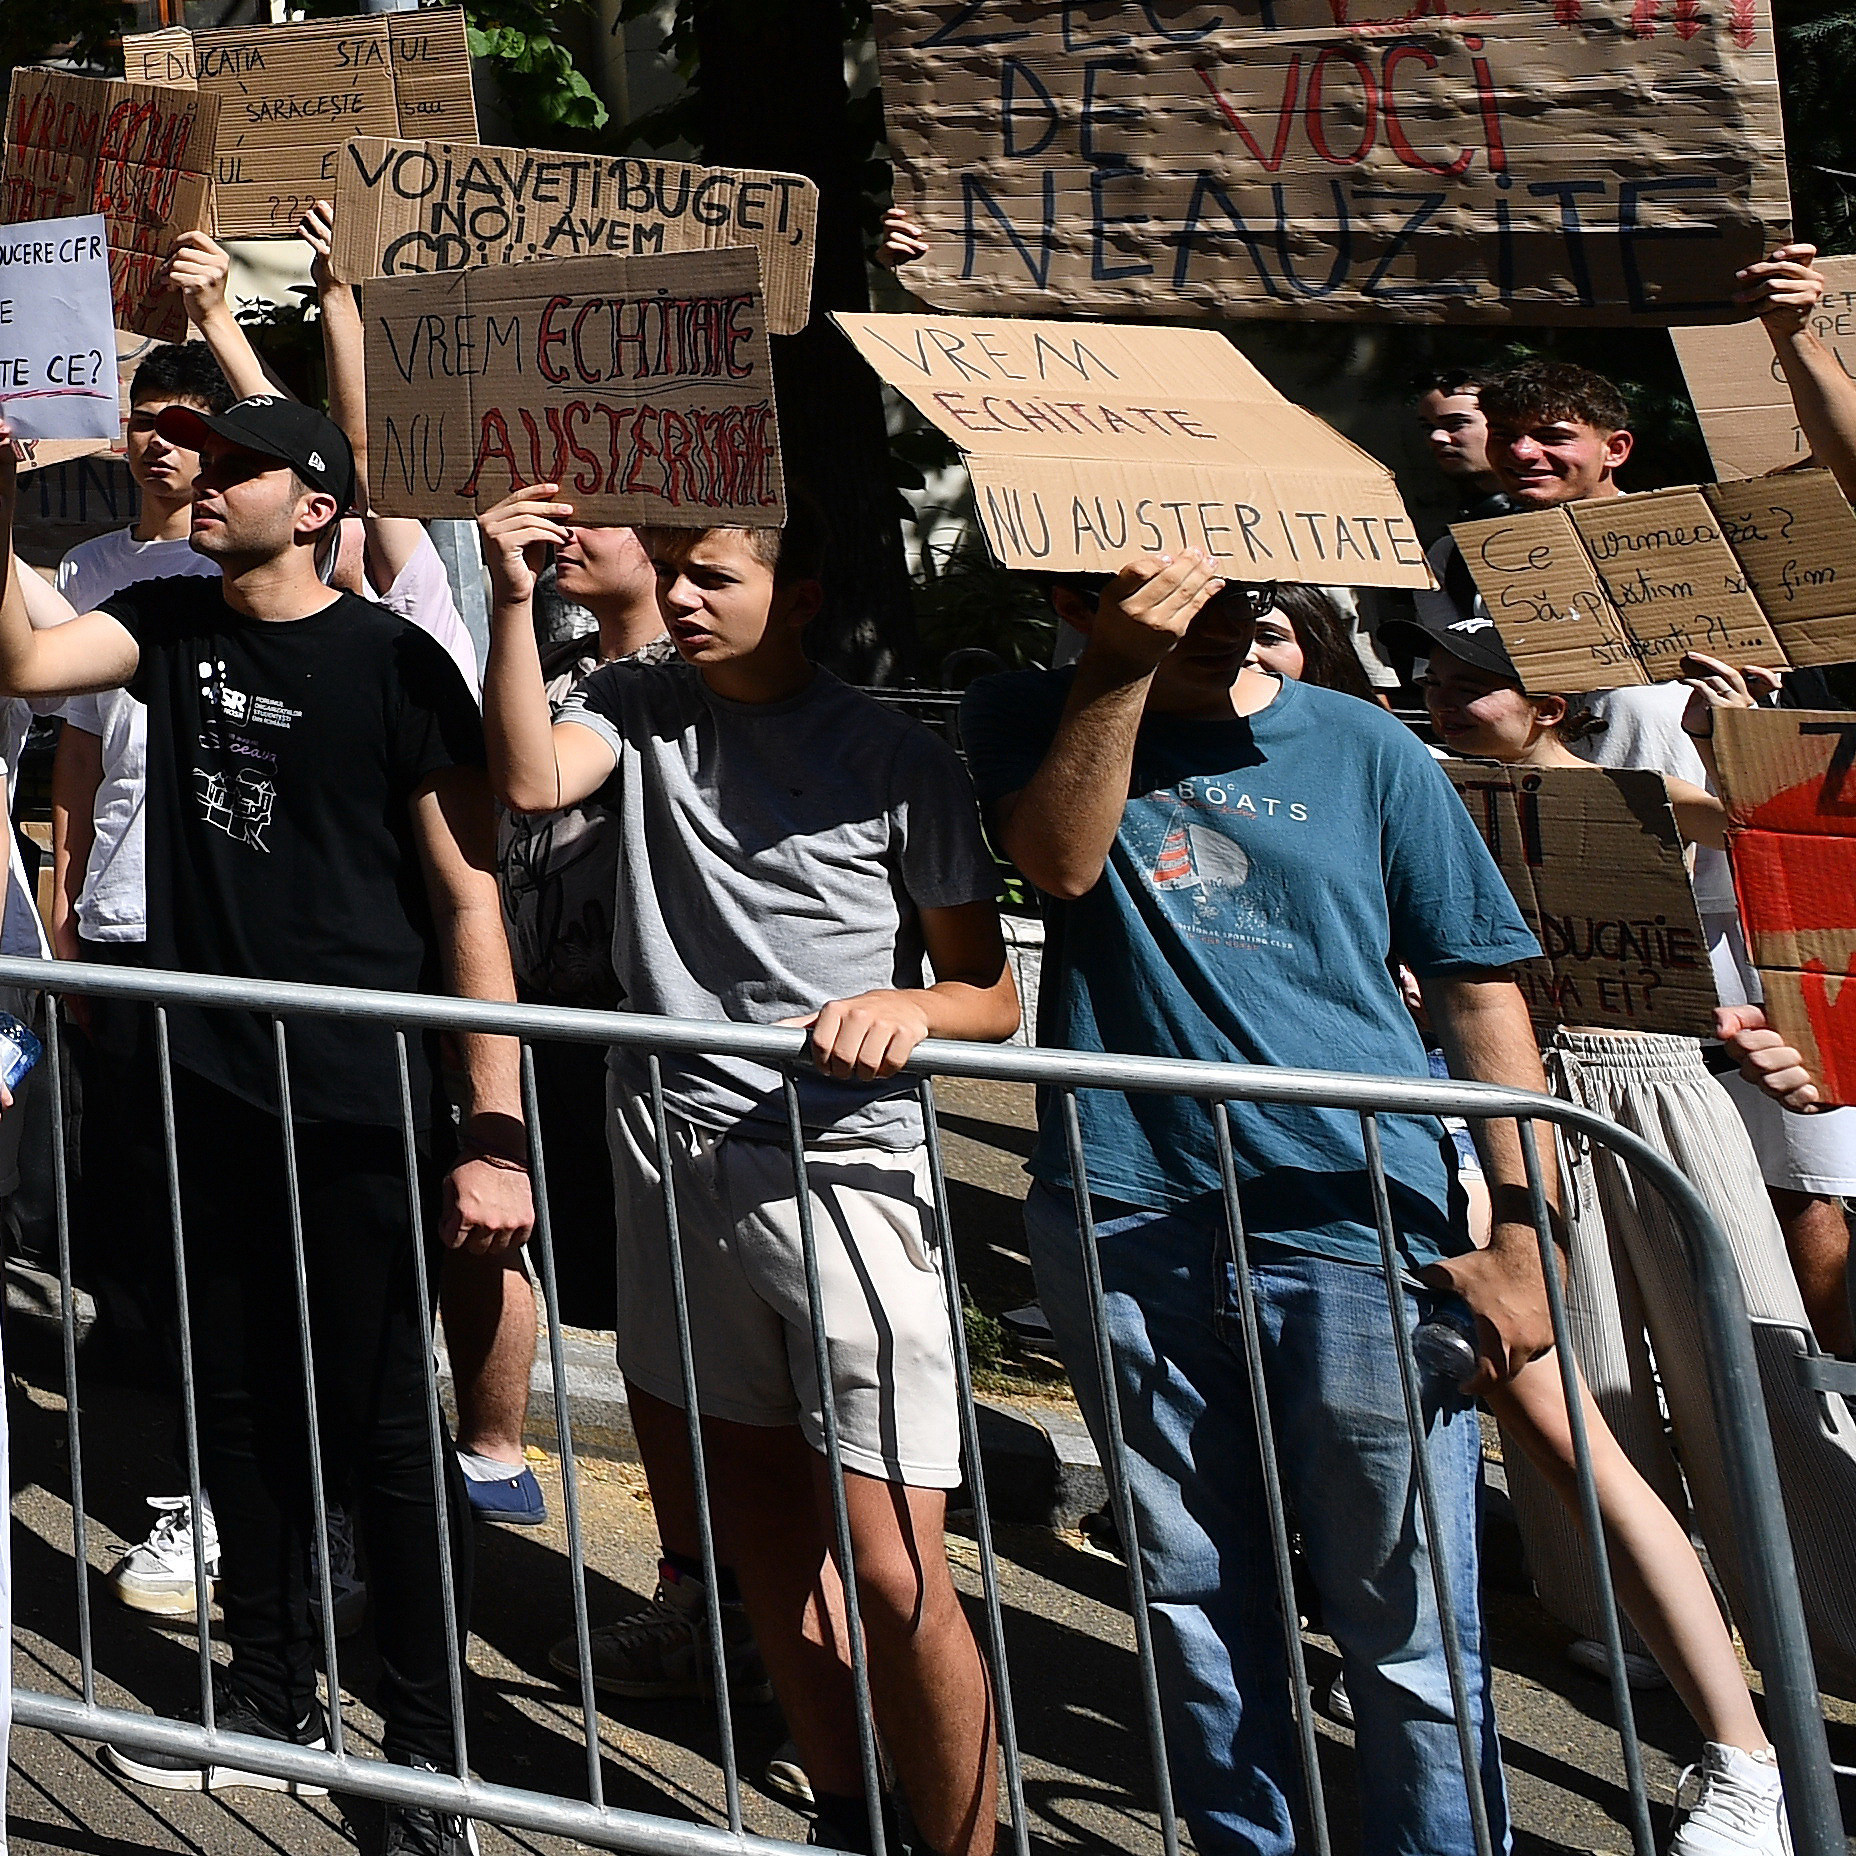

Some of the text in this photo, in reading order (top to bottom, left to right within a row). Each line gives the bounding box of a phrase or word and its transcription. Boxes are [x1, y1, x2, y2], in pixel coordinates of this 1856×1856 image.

[336, 36, 440, 67] STATUL
[1000, 34, 1506, 176] DE VOCI
[348, 143, 453, 202] VOI
[59, 235, 103, 266] CFR
[432, 201, 665, 255] NOI AVEM
[960, 169, 1735, 313] NEAUZITE
[381, 289, 756, 385] VREM ECHITATE
[864, 325, 1119, 382] VREM
[47, 349, 104, 388] CE?
[933, 391, 1218, 440] ECHITATE
[385, 411, 446, 498] NU
[985, 485, 1425, 566] NU AUSTERITATE
[1481, 528, 1555, 573] Ce
[1779, 558, 1836, 602] fim
